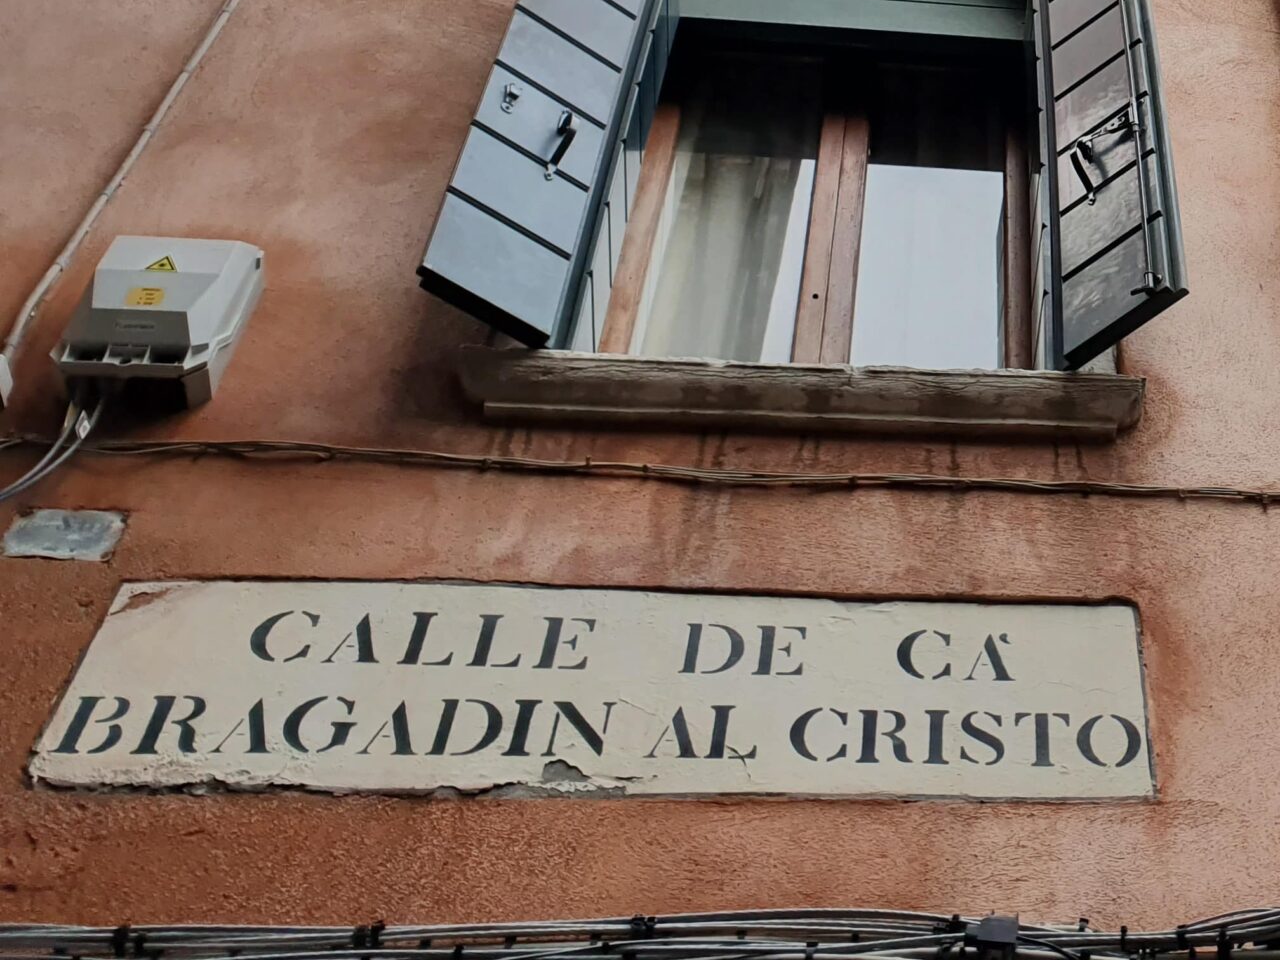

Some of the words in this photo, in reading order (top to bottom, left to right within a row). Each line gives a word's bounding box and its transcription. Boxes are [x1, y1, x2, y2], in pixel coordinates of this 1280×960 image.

[250, 610, 596, 670] CALLE
[678, 623, 807, 676] DE
[47, 695, 617, 757] BRAGADIN
[643, 705, 757, 759] AL
[789, 707, 1142, 768] CRISTO
